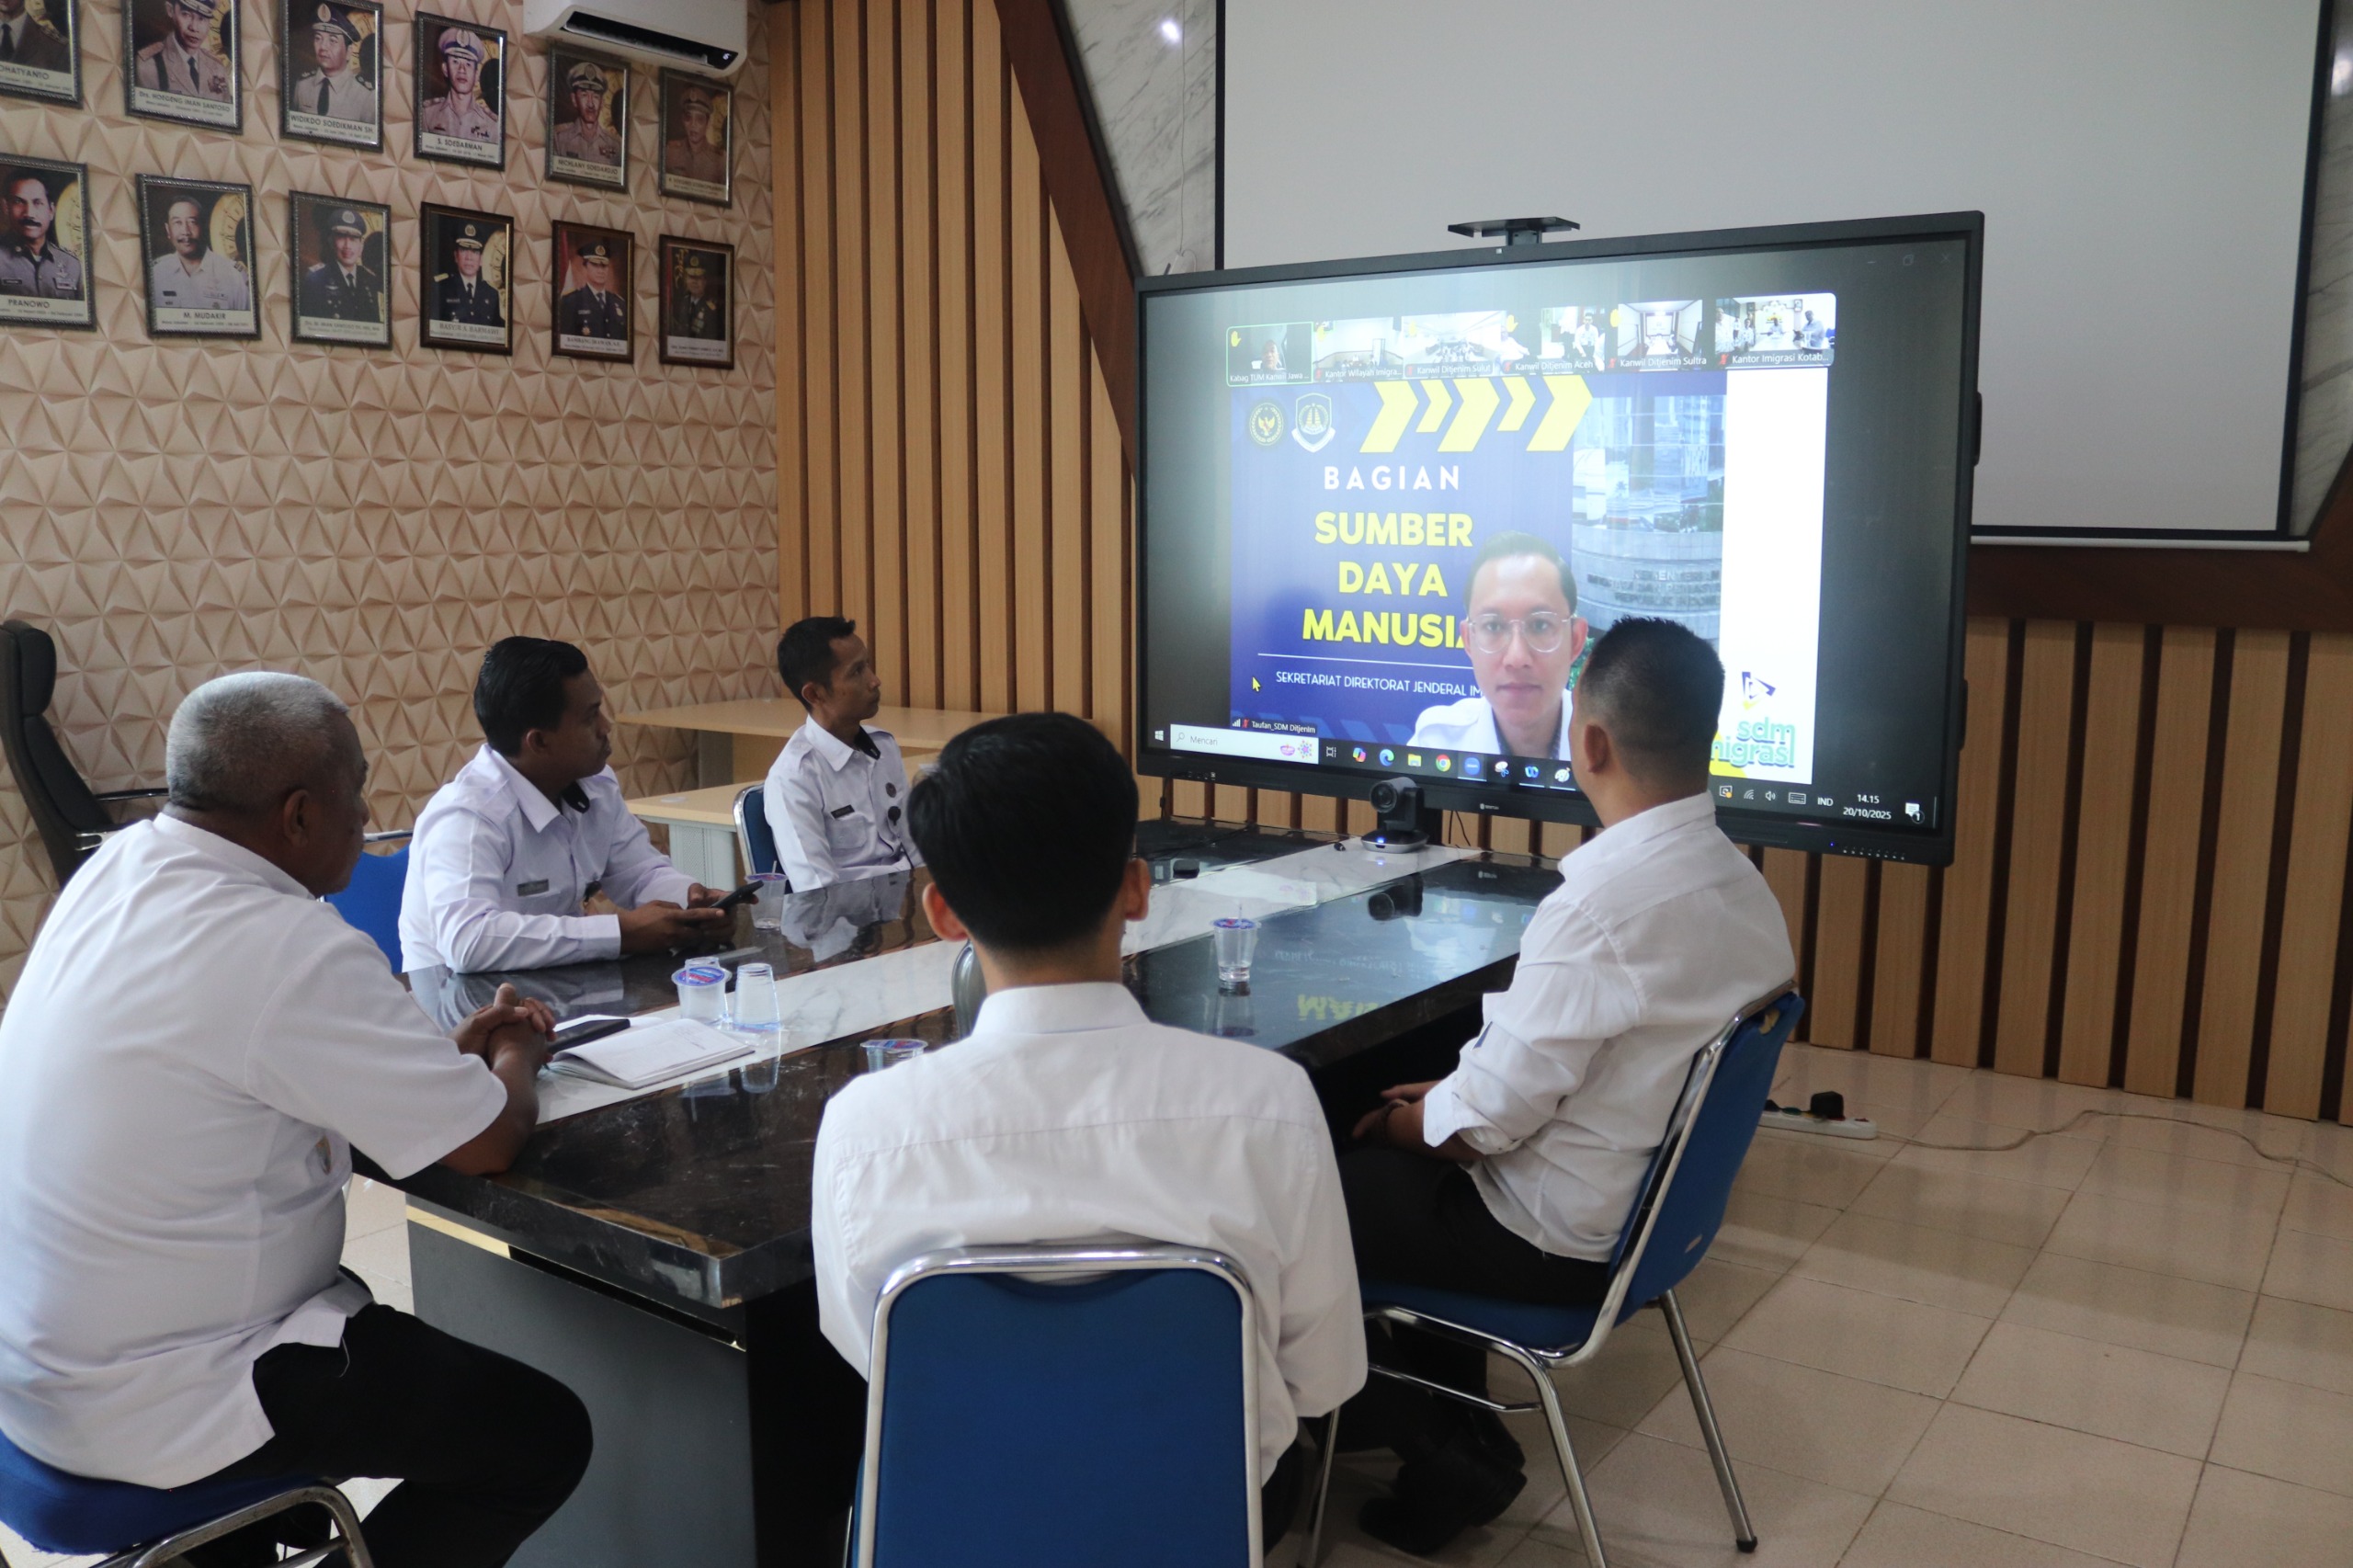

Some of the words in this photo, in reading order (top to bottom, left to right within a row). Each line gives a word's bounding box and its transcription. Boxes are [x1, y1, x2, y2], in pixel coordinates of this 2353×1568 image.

[445, 139, 483, 151] SOEDARMAN
[7, 299, 51, 309] PRANOWO
[1515, 362, 1540, 371] Kanwil
[1541, 361, 1573, 371] Ditjenim
[1574, 359, 1593, 369] Aceh
[1620, 358, 1645, 368] Kanwil
[1647, 358, 1682, 368] Ditjenim
[1683, 357, 1707, 366] Sultra
[1732, 355, 1760, 364] Kantor
[1761, 353, 1795, 365] Imigrasi
[1324, 370, 1347, 379] Kantor
[1348, 369, 1375, 379] Wilayah
[1416, 366, 1440, 374] Kanwil
[1441, 364, 1472, 375] Ditjenim
[1472, 363, 1491, 372] Sulut
[1230, 374, 1249, 383] Kabag
[1266, 371, 1287, 381] Kanwil
[1288, 371, 1303, 380] Jawa
[1324, 465, 1460, 491] BAGIAN
[1314, 511, 1473, 547] SUMBER
[1338, 561, 1449, 597] DAYA
[1275, 671, 1342, 687] SEKRETARIAT
[1344, 676, 1411, 691] DIREKTORAT
[1413, 681, 1467, 697] JENDERAL
[1251, 721, 1289, 732] Taufan_SDM
[1737, 717, 1795, 742] sdm
[1189, 735, 1218, 746] Mencari
[1817, 797, 1834, 807] IND
[1857, 794, 1880, 804] 14.15
[1843, 806, 1892, 820] 20/10/2025
